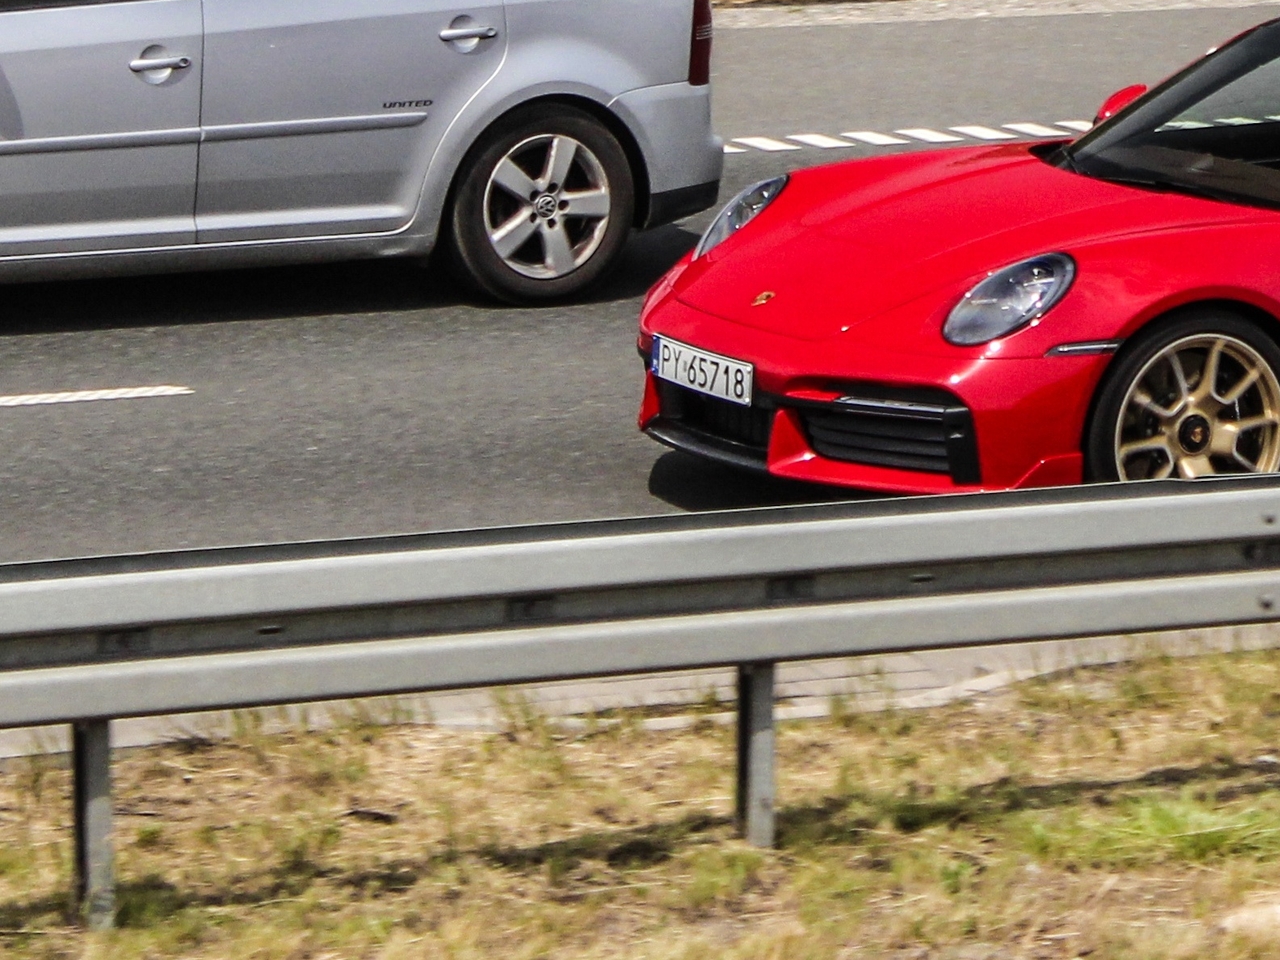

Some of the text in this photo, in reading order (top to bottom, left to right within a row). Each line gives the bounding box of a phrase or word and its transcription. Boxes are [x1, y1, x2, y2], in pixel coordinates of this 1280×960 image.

[382, 99, 434, 109] UNITED
[661, 344, 745, 399] PY 65718
